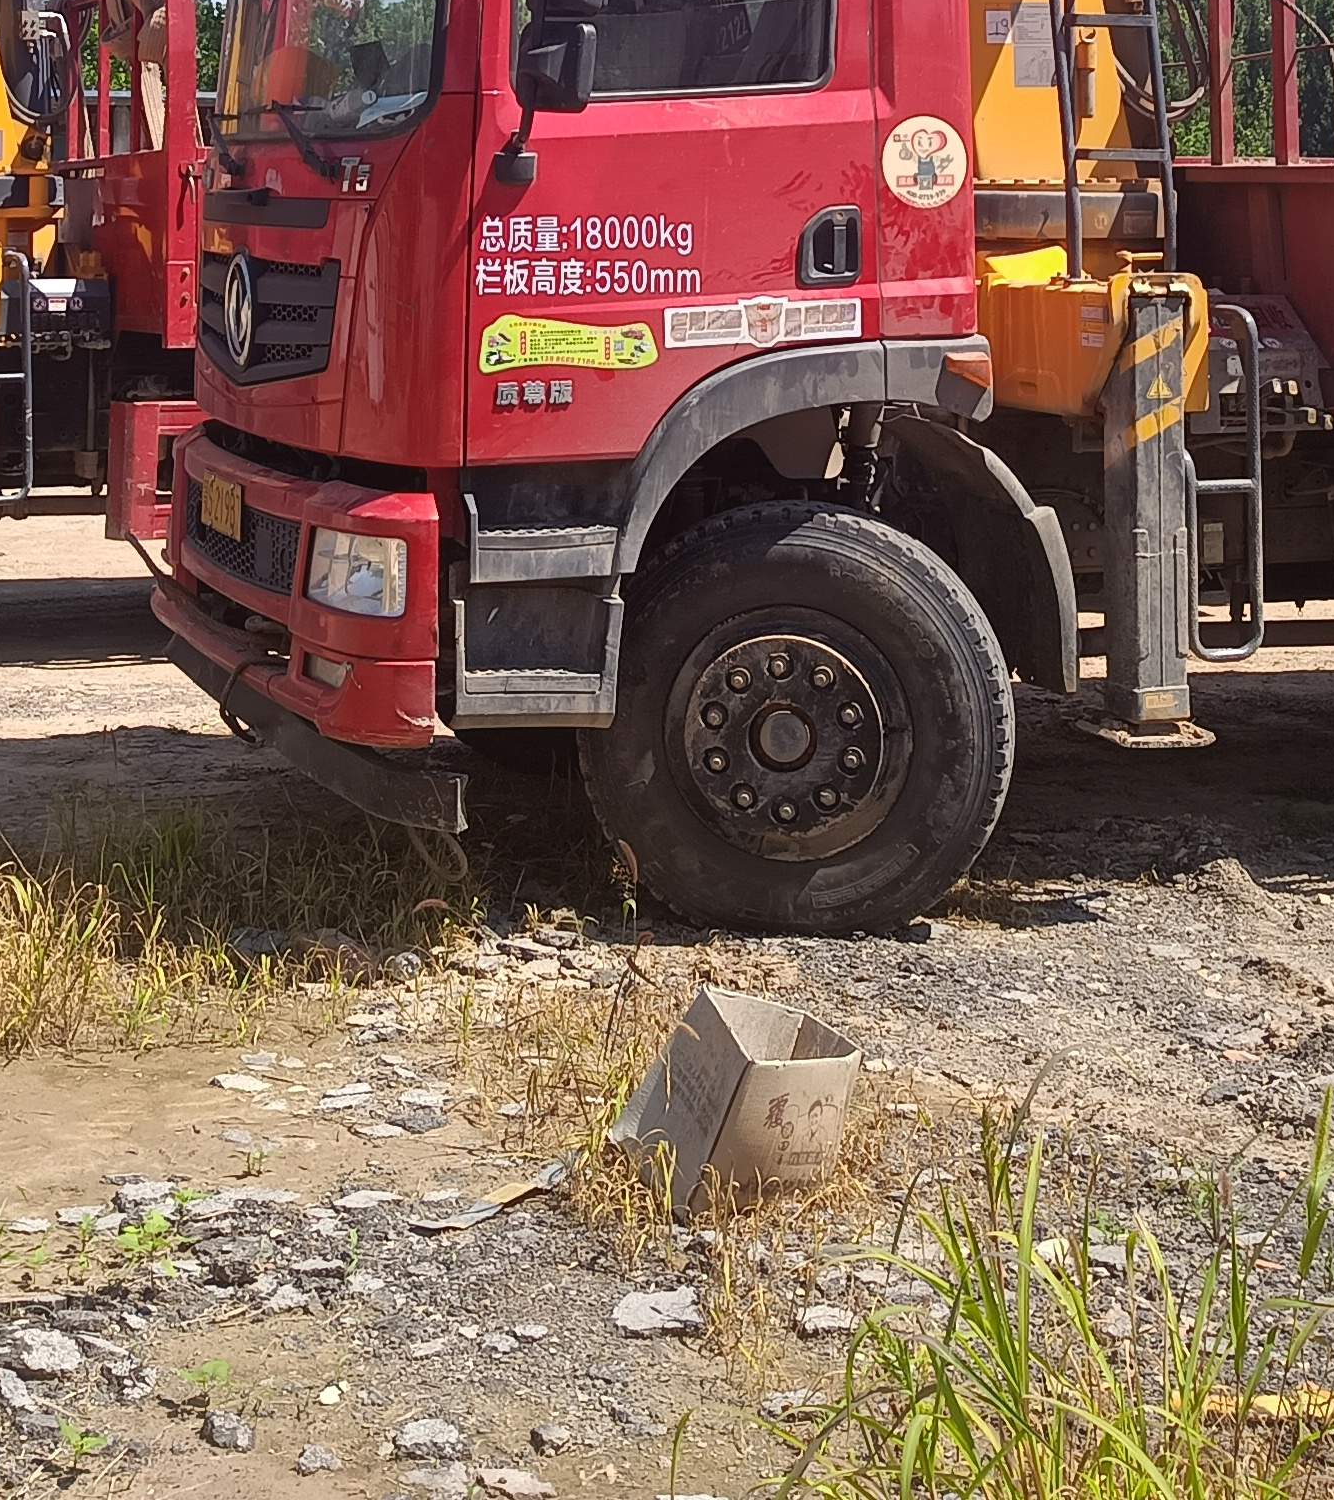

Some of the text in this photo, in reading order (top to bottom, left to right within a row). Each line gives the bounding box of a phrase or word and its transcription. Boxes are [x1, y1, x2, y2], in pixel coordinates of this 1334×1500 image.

[341, 157, 371, 192] T5
[480, 215, 693, 255] 总质量:18000kg
[476, 258, 701, 295] 栏板高度:550mm
